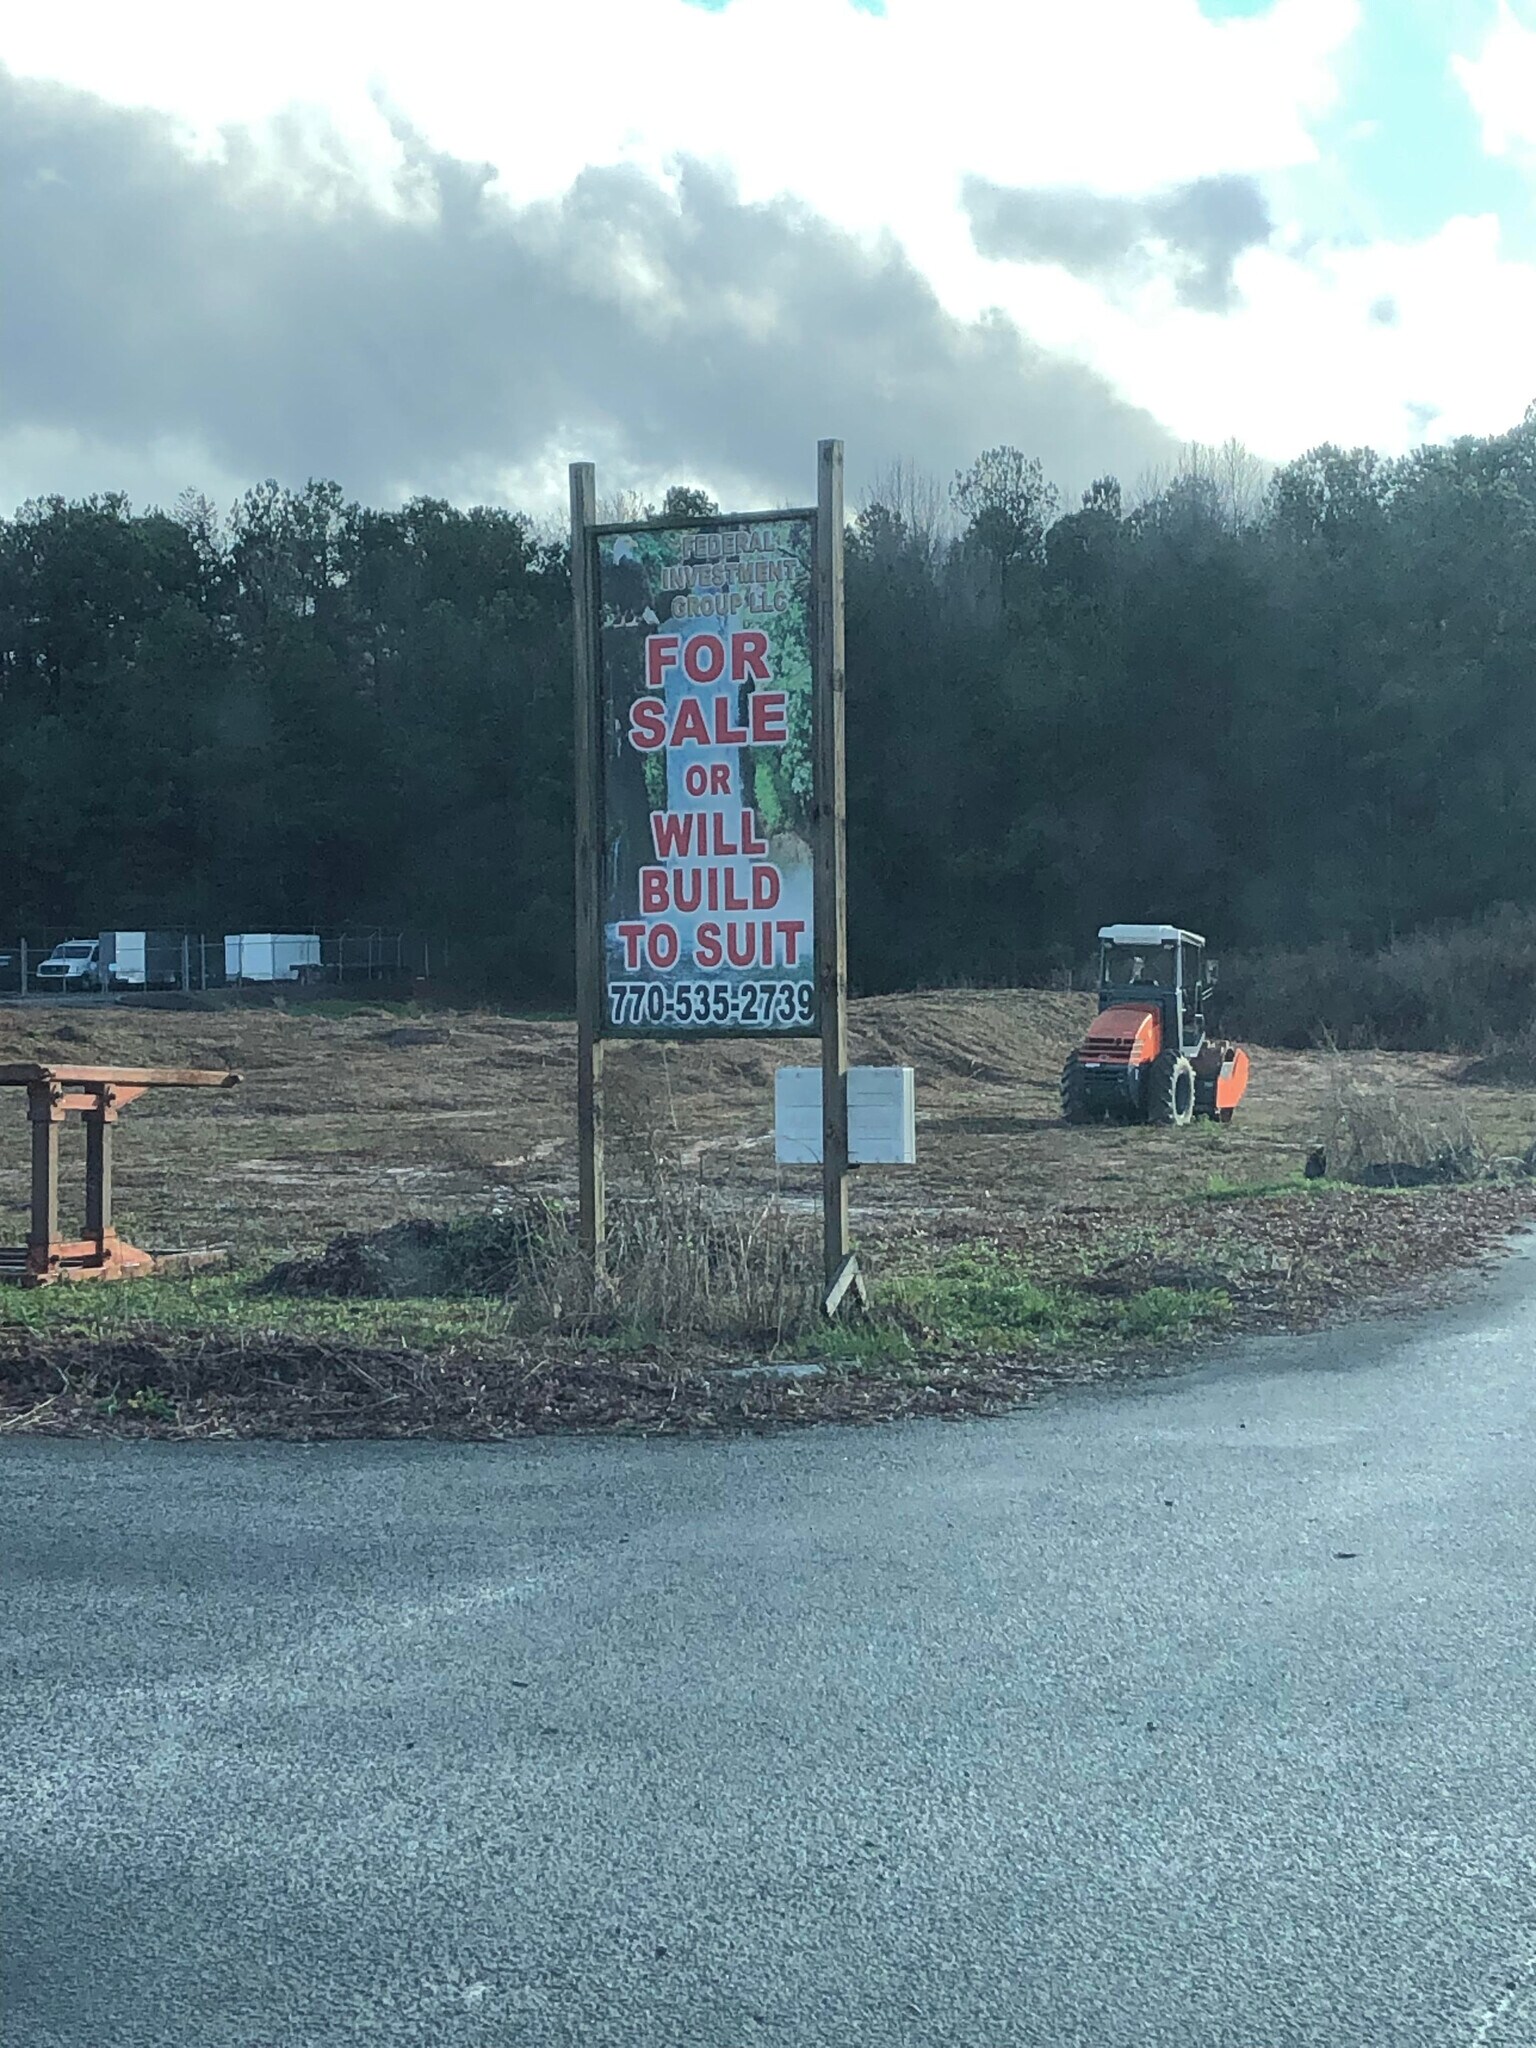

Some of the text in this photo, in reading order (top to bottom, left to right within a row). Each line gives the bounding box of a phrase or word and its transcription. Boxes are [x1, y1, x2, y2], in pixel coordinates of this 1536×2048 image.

[682, 531, 775, 559] FEDERAL
[661, 558, 798, 590] INVESTMENT
[671, 590, 789, 619] GROUP LLC
[647, 632, 771, 686] FOR
[631, 693, 787, 749] SALE
[685, 764, 732, 797] OR
[652, 811, 767, 858] WILL
[641, 866, 781, 914] BUILD
[617, 920, 805, 969] TO SUIT
[610, 984, 814, 1023] 770-535-2739
